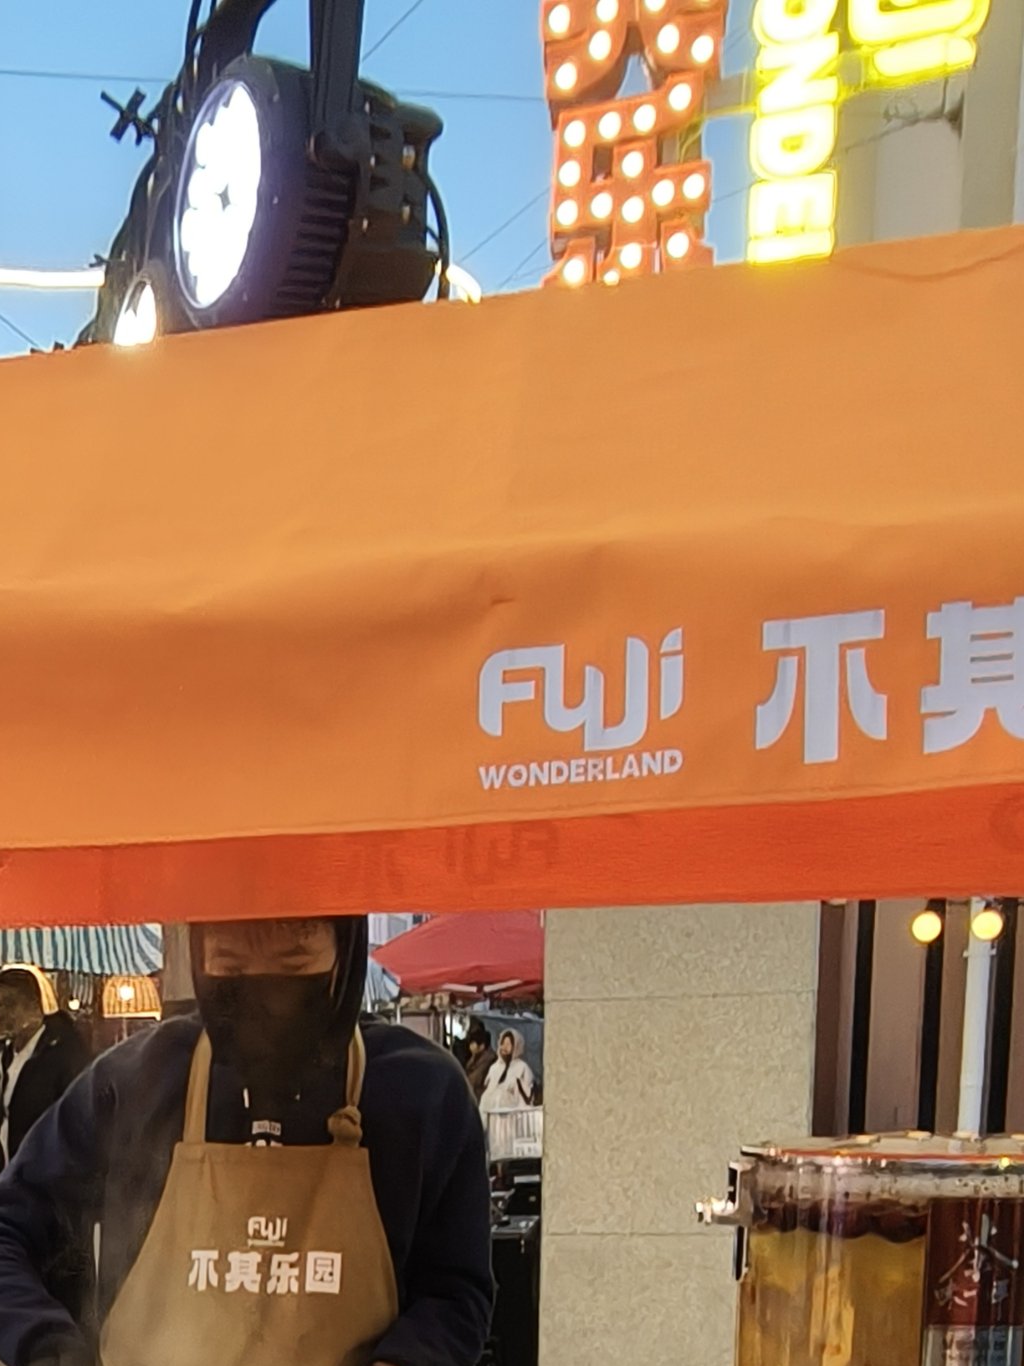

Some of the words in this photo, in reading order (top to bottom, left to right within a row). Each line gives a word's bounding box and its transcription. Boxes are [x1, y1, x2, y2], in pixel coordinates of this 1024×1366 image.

[755, 596, 1024, 765] 不其
[479, 749, 684, 790] WONDERLAND
[188, 1249, 343, 1295] 不其乐园
